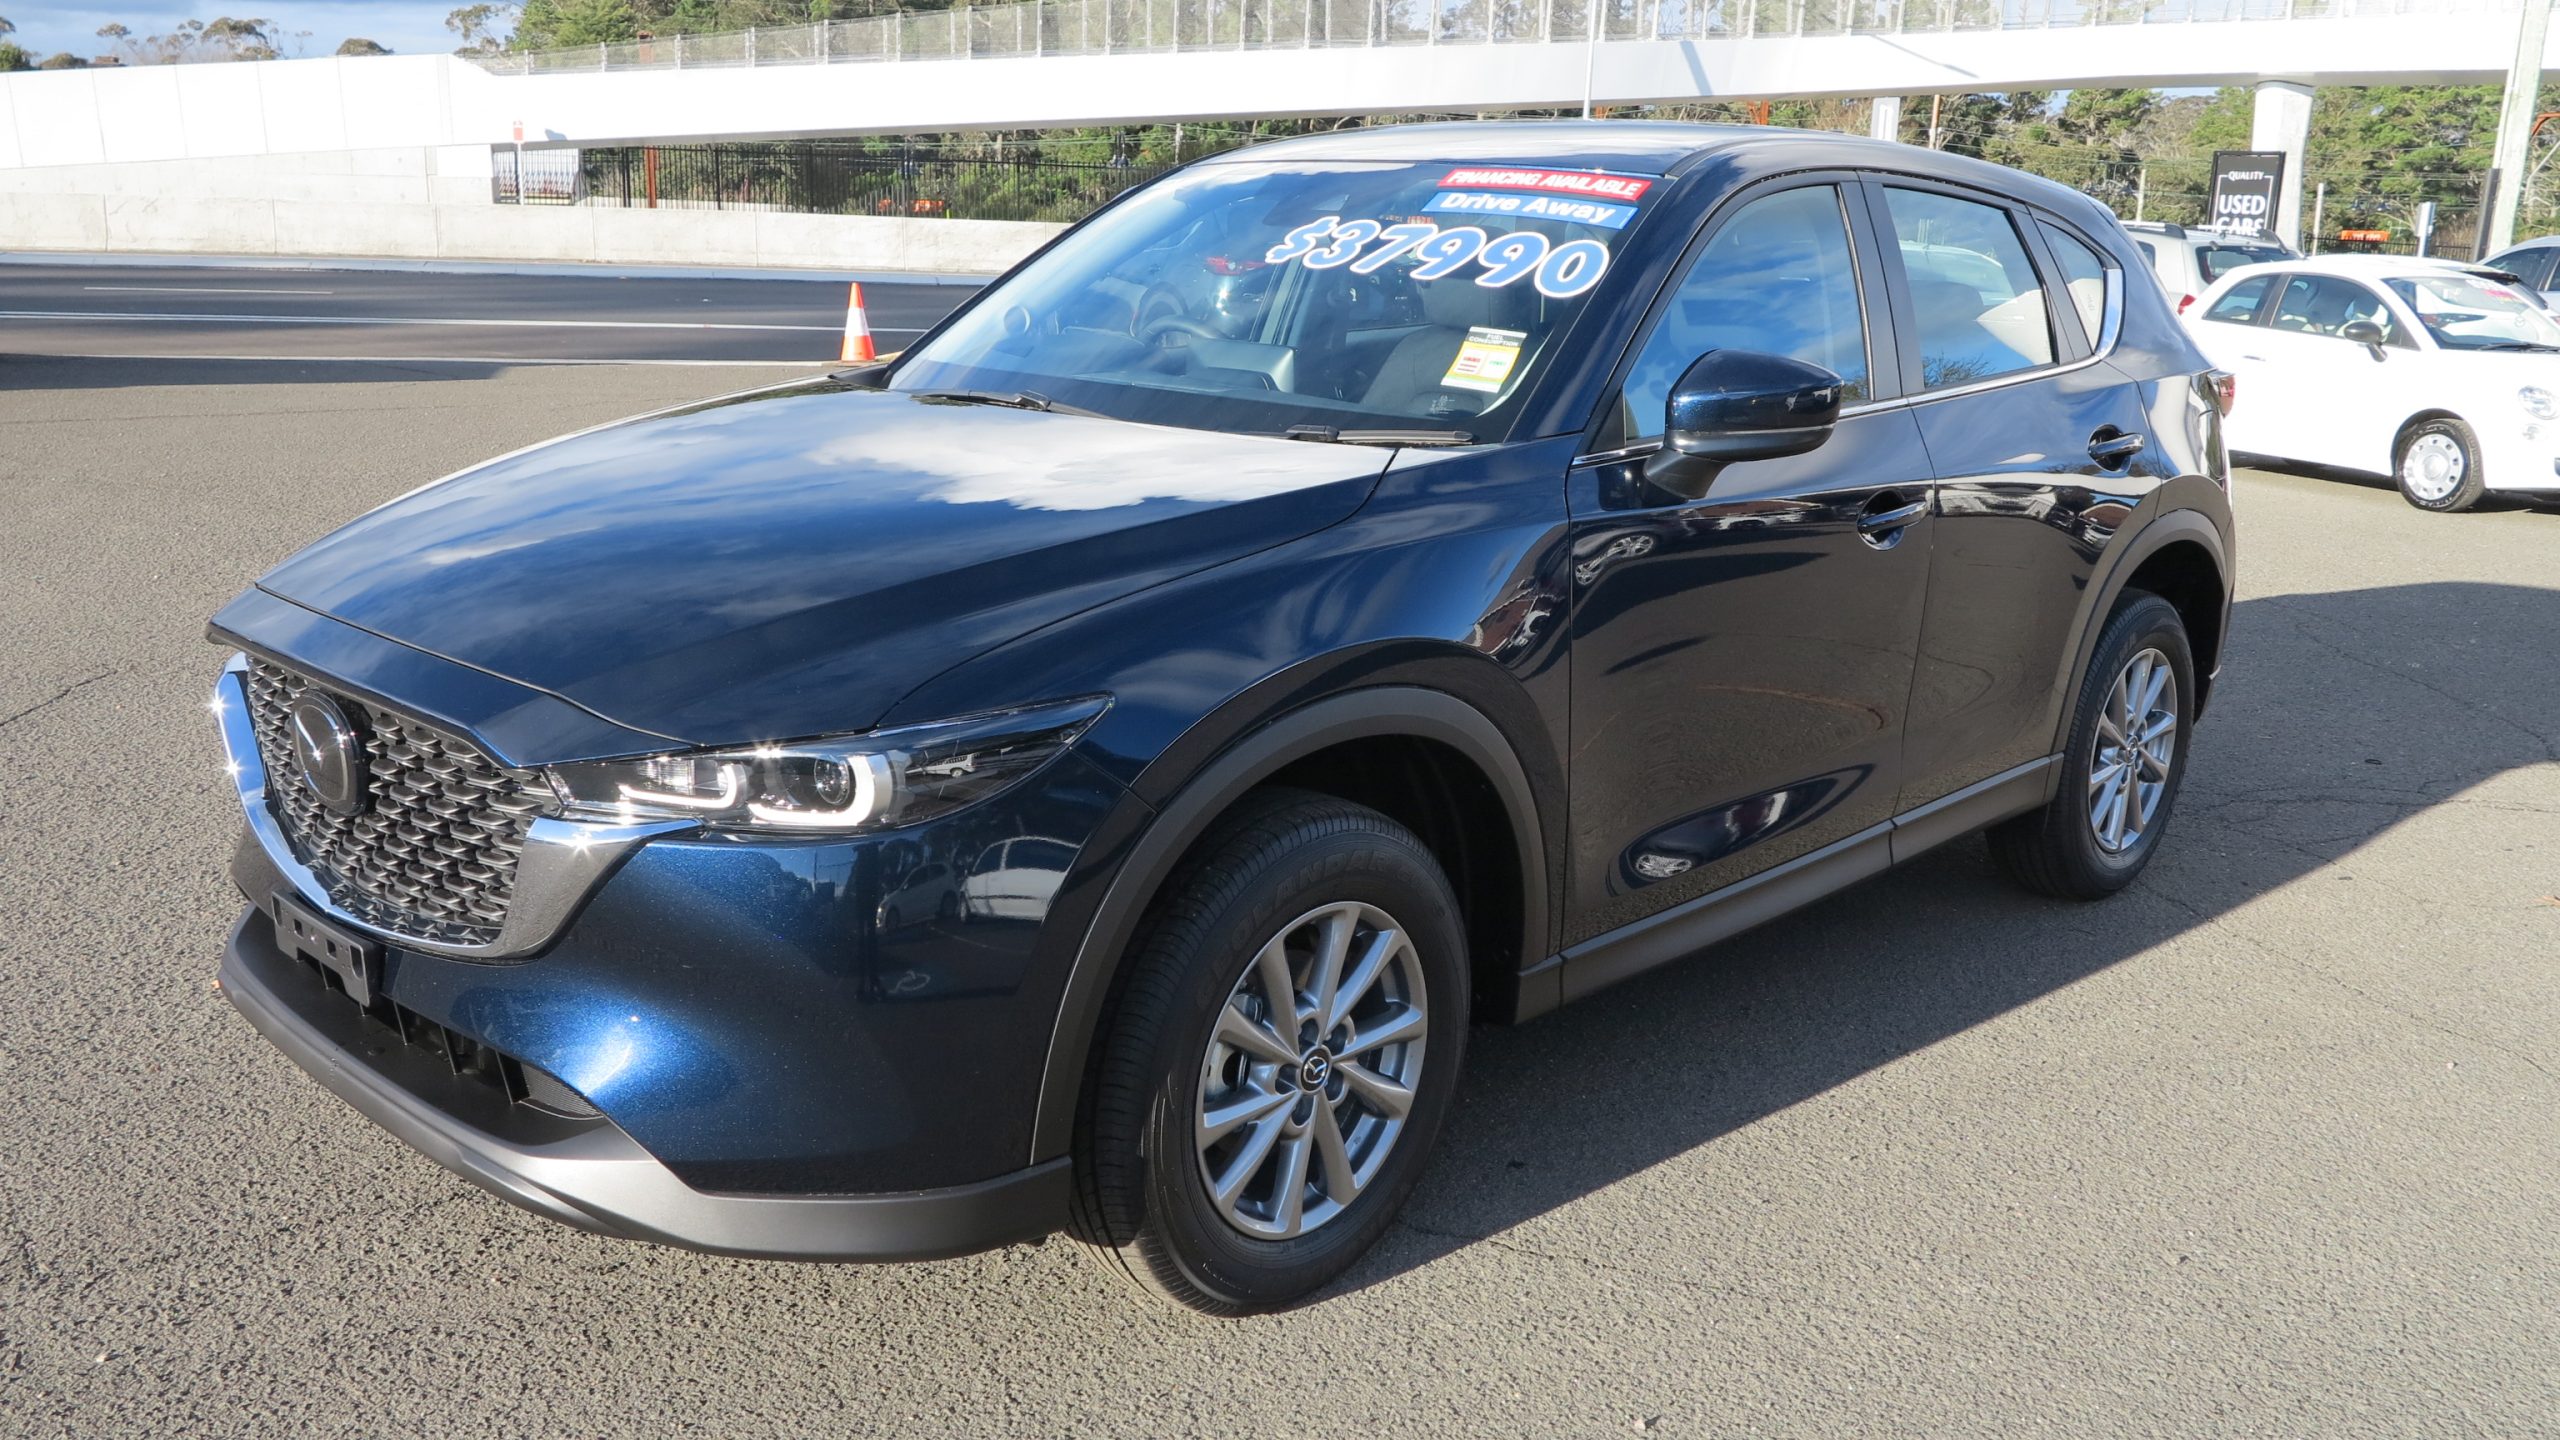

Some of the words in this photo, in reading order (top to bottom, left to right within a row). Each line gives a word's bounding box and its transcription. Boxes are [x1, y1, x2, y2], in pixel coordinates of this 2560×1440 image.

[1447, 171, 1540, 186] FINANCING
[1541, 174, 1642, 196] AVAILABLE
[2228, 171, 2264, 181] QUALITY
[1440, 193, 1519, 211] Drive
[1522, 197, 1616, 223] Away
[2219, 194, 2266, 215] USED
[2216, 216, 2264, 236] CARS
[1265, 216, 1609, 298] $37990
